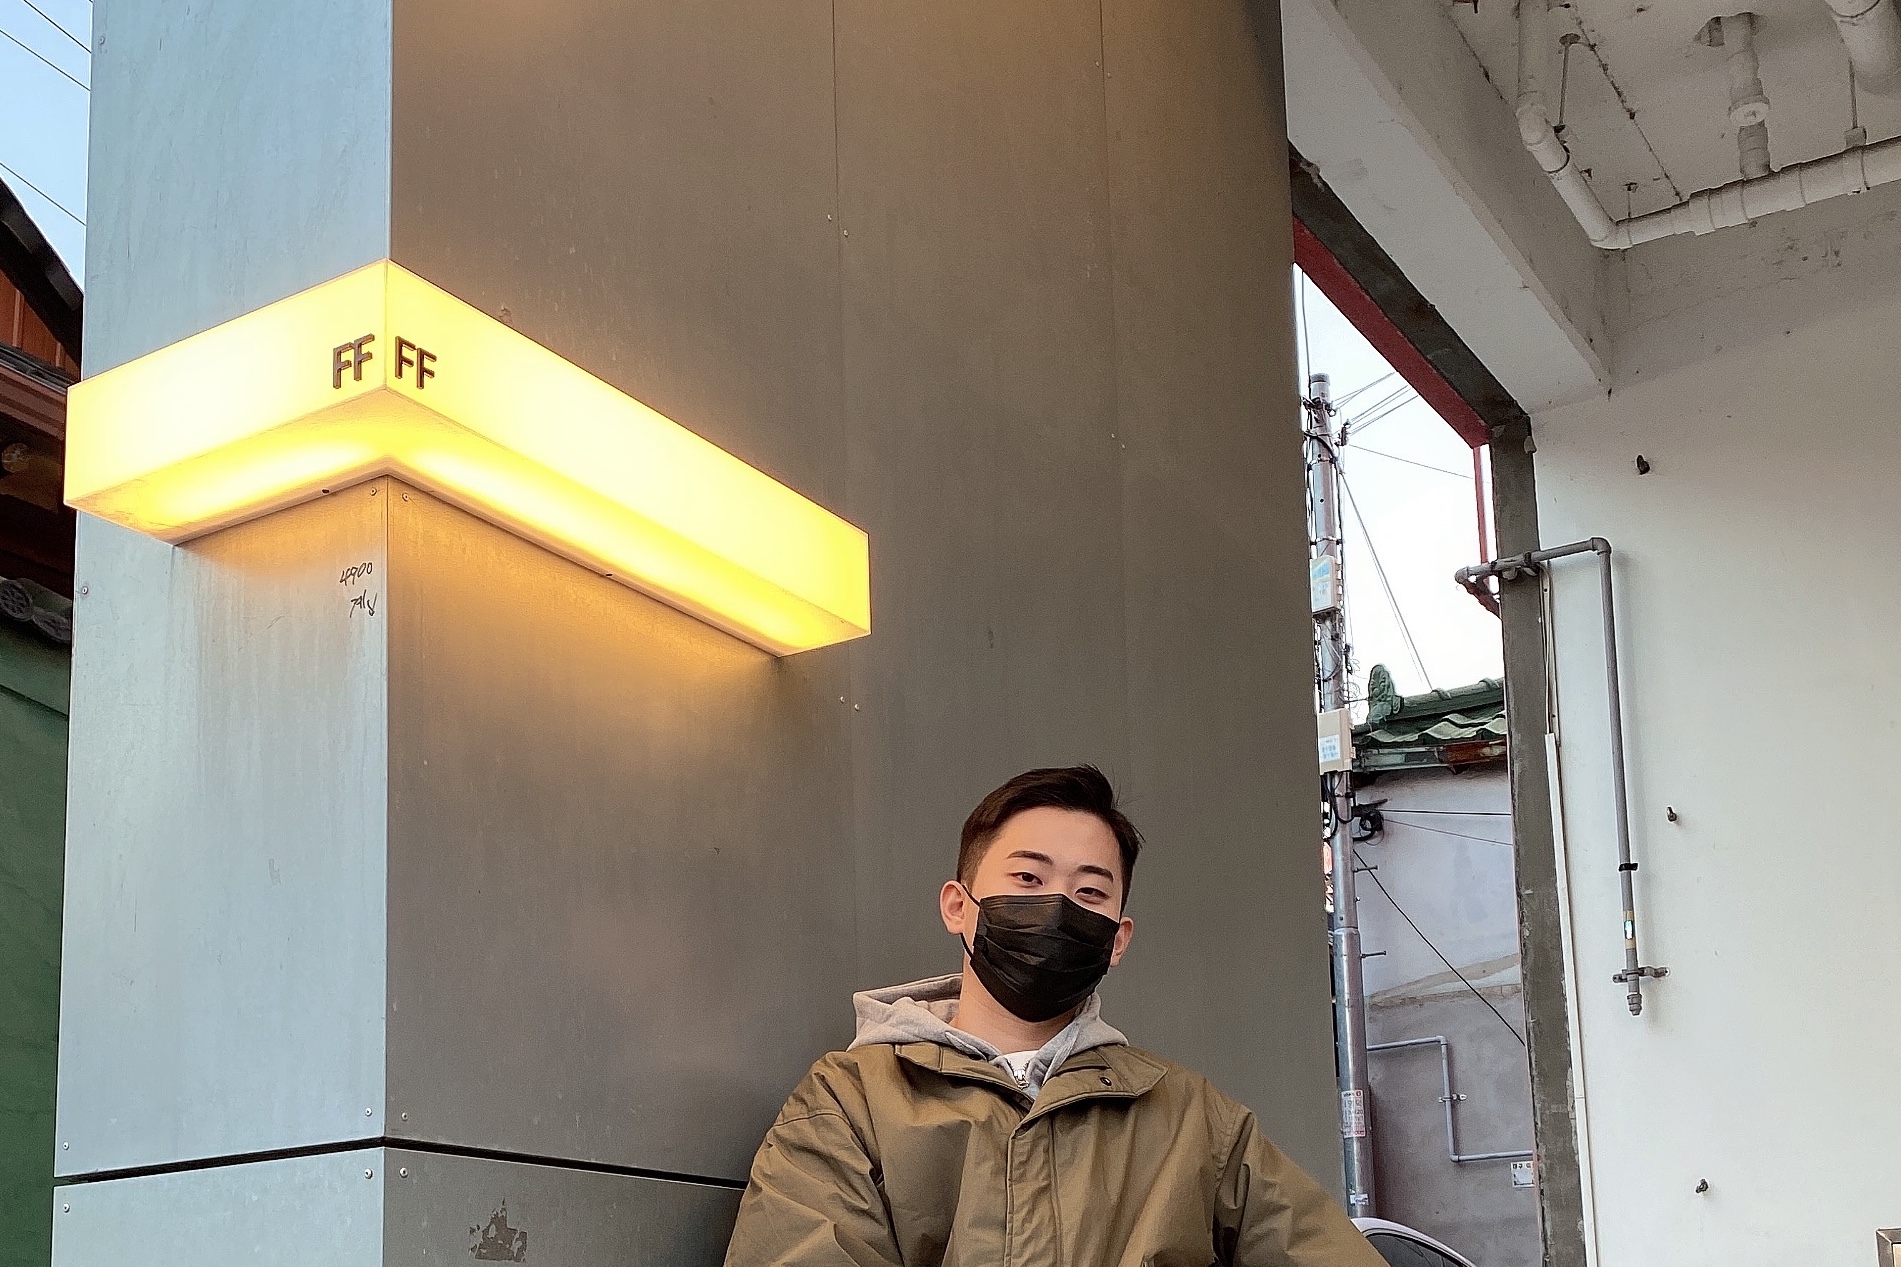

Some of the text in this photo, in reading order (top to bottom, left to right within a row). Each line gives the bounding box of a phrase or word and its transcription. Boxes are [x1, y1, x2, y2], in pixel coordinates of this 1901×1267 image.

[333, 333, 375, 389] FF
[395, 336, 437, 390] FF
[339, 562, 373, 586] 4900
